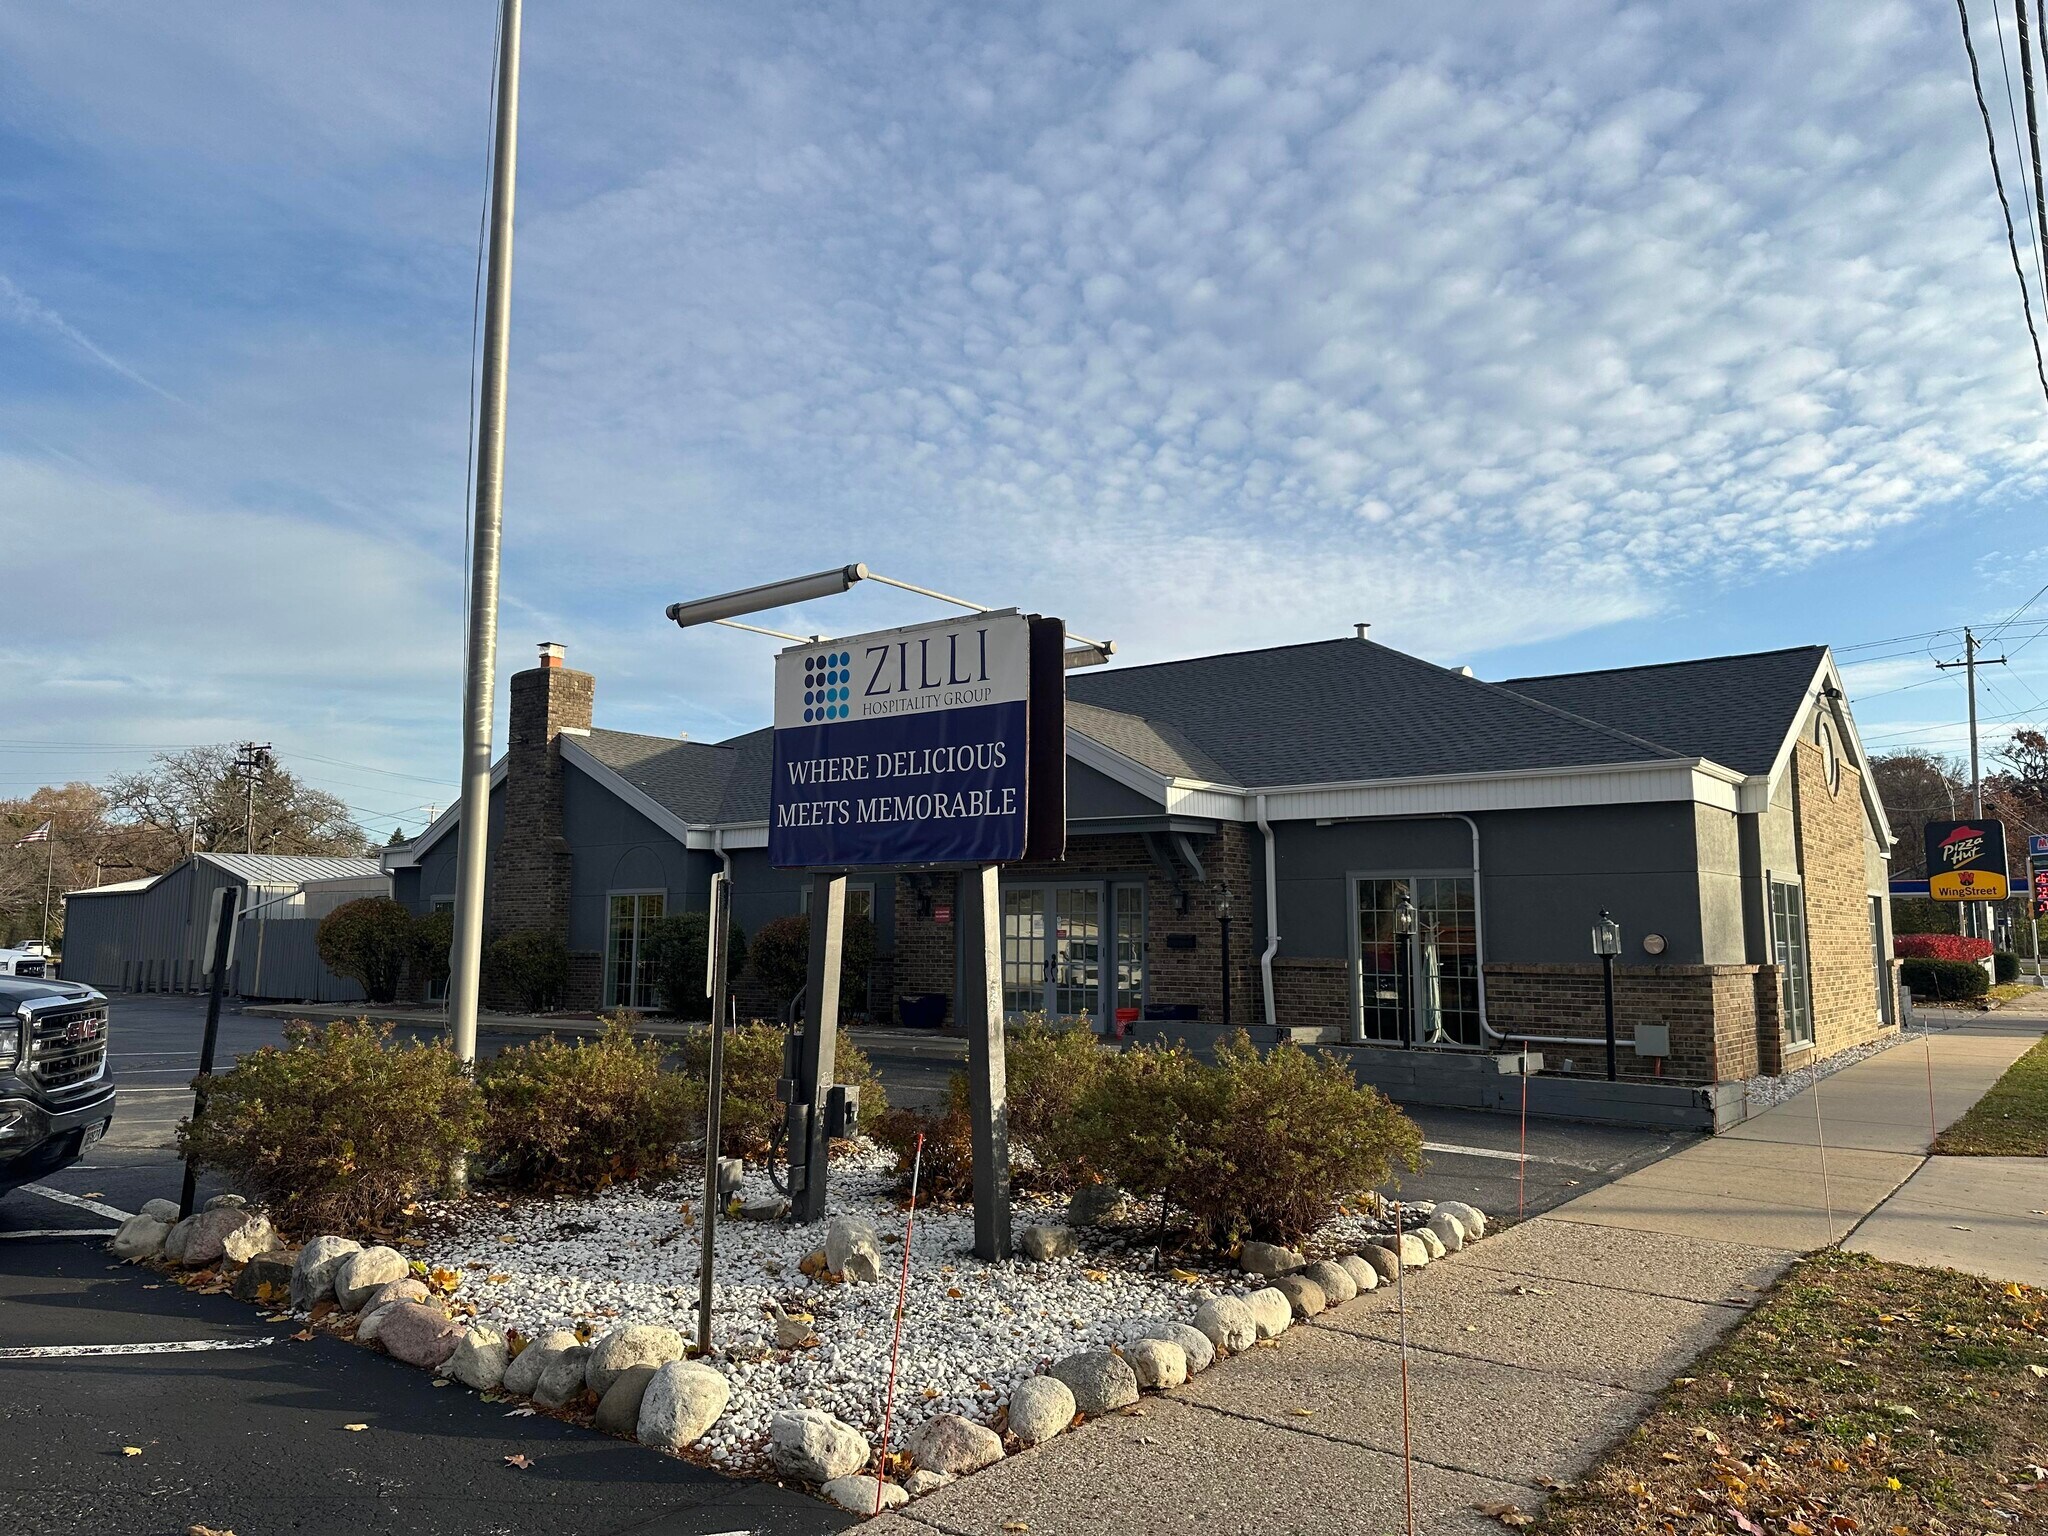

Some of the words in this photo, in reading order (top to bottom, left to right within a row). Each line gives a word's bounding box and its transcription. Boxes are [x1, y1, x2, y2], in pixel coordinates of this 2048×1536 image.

[864, 629, 990, 696] ZILLI
[863, 694, 941, 716] HOSPITALITY
[944, 688, 991, 706] GROUP
[787, 755, 869, 785] WHERE
[876, 741, 1007, 778] DELICIOUS
[777, 800, 850, 828] MEETS
[856, 788, 1017, 823] MEMORABLE
[1943, 837, 1984, 861] Pizza
[1951, 846, 1981, 865] Hut
[1939, 886, 1998, 898] WingStreet
[66, 1018, 98, 1040] GMC
